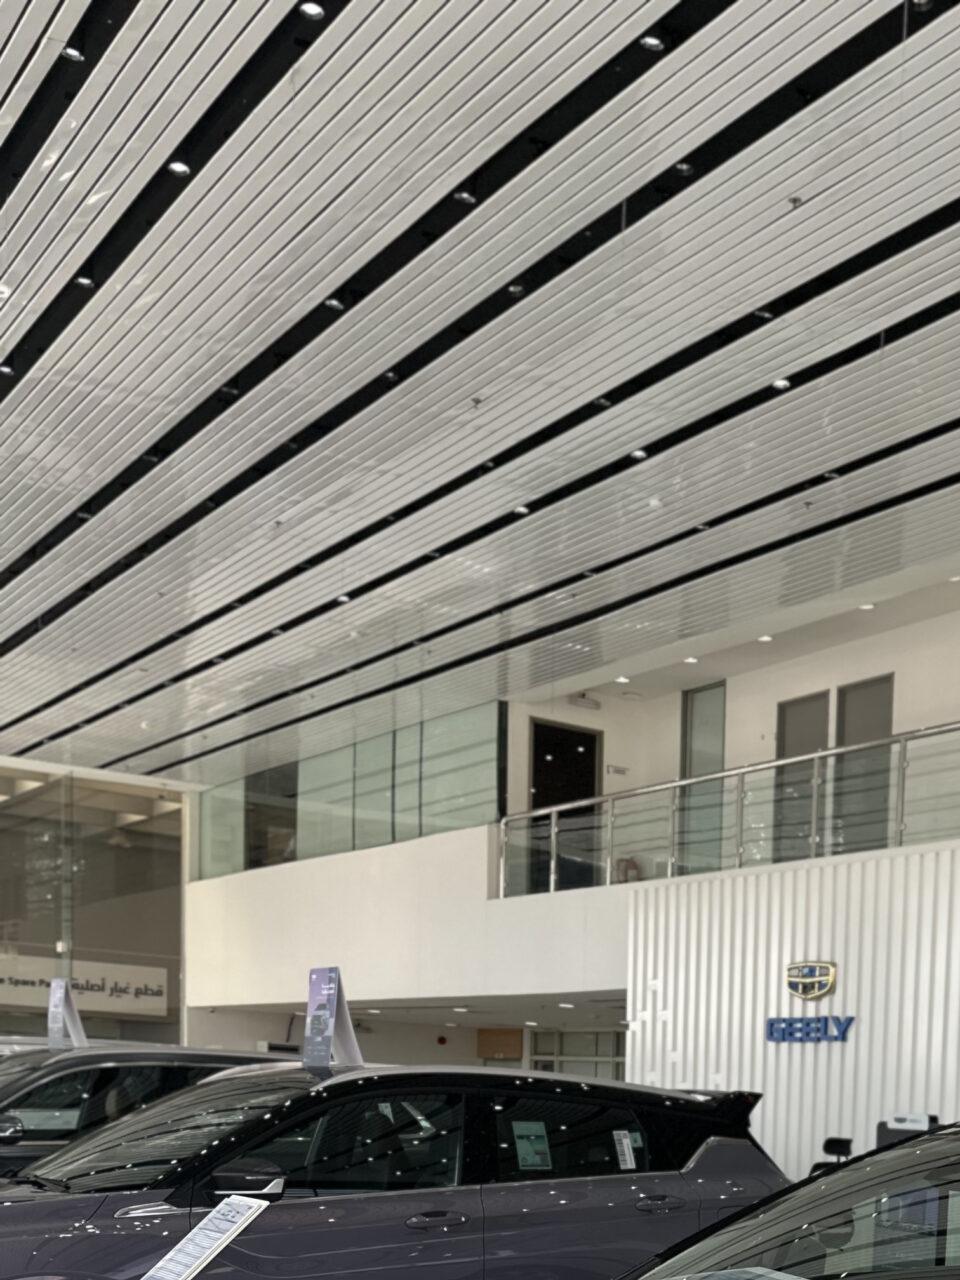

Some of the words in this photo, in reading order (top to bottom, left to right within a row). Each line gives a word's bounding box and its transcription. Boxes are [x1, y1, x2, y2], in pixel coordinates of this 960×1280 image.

[8, 976, 36, 988] Spare
[109, 981, 130, 998] غيار
[134, 984, 164, 999] قطع
[766, 1016, 855, 1042] GEELY
